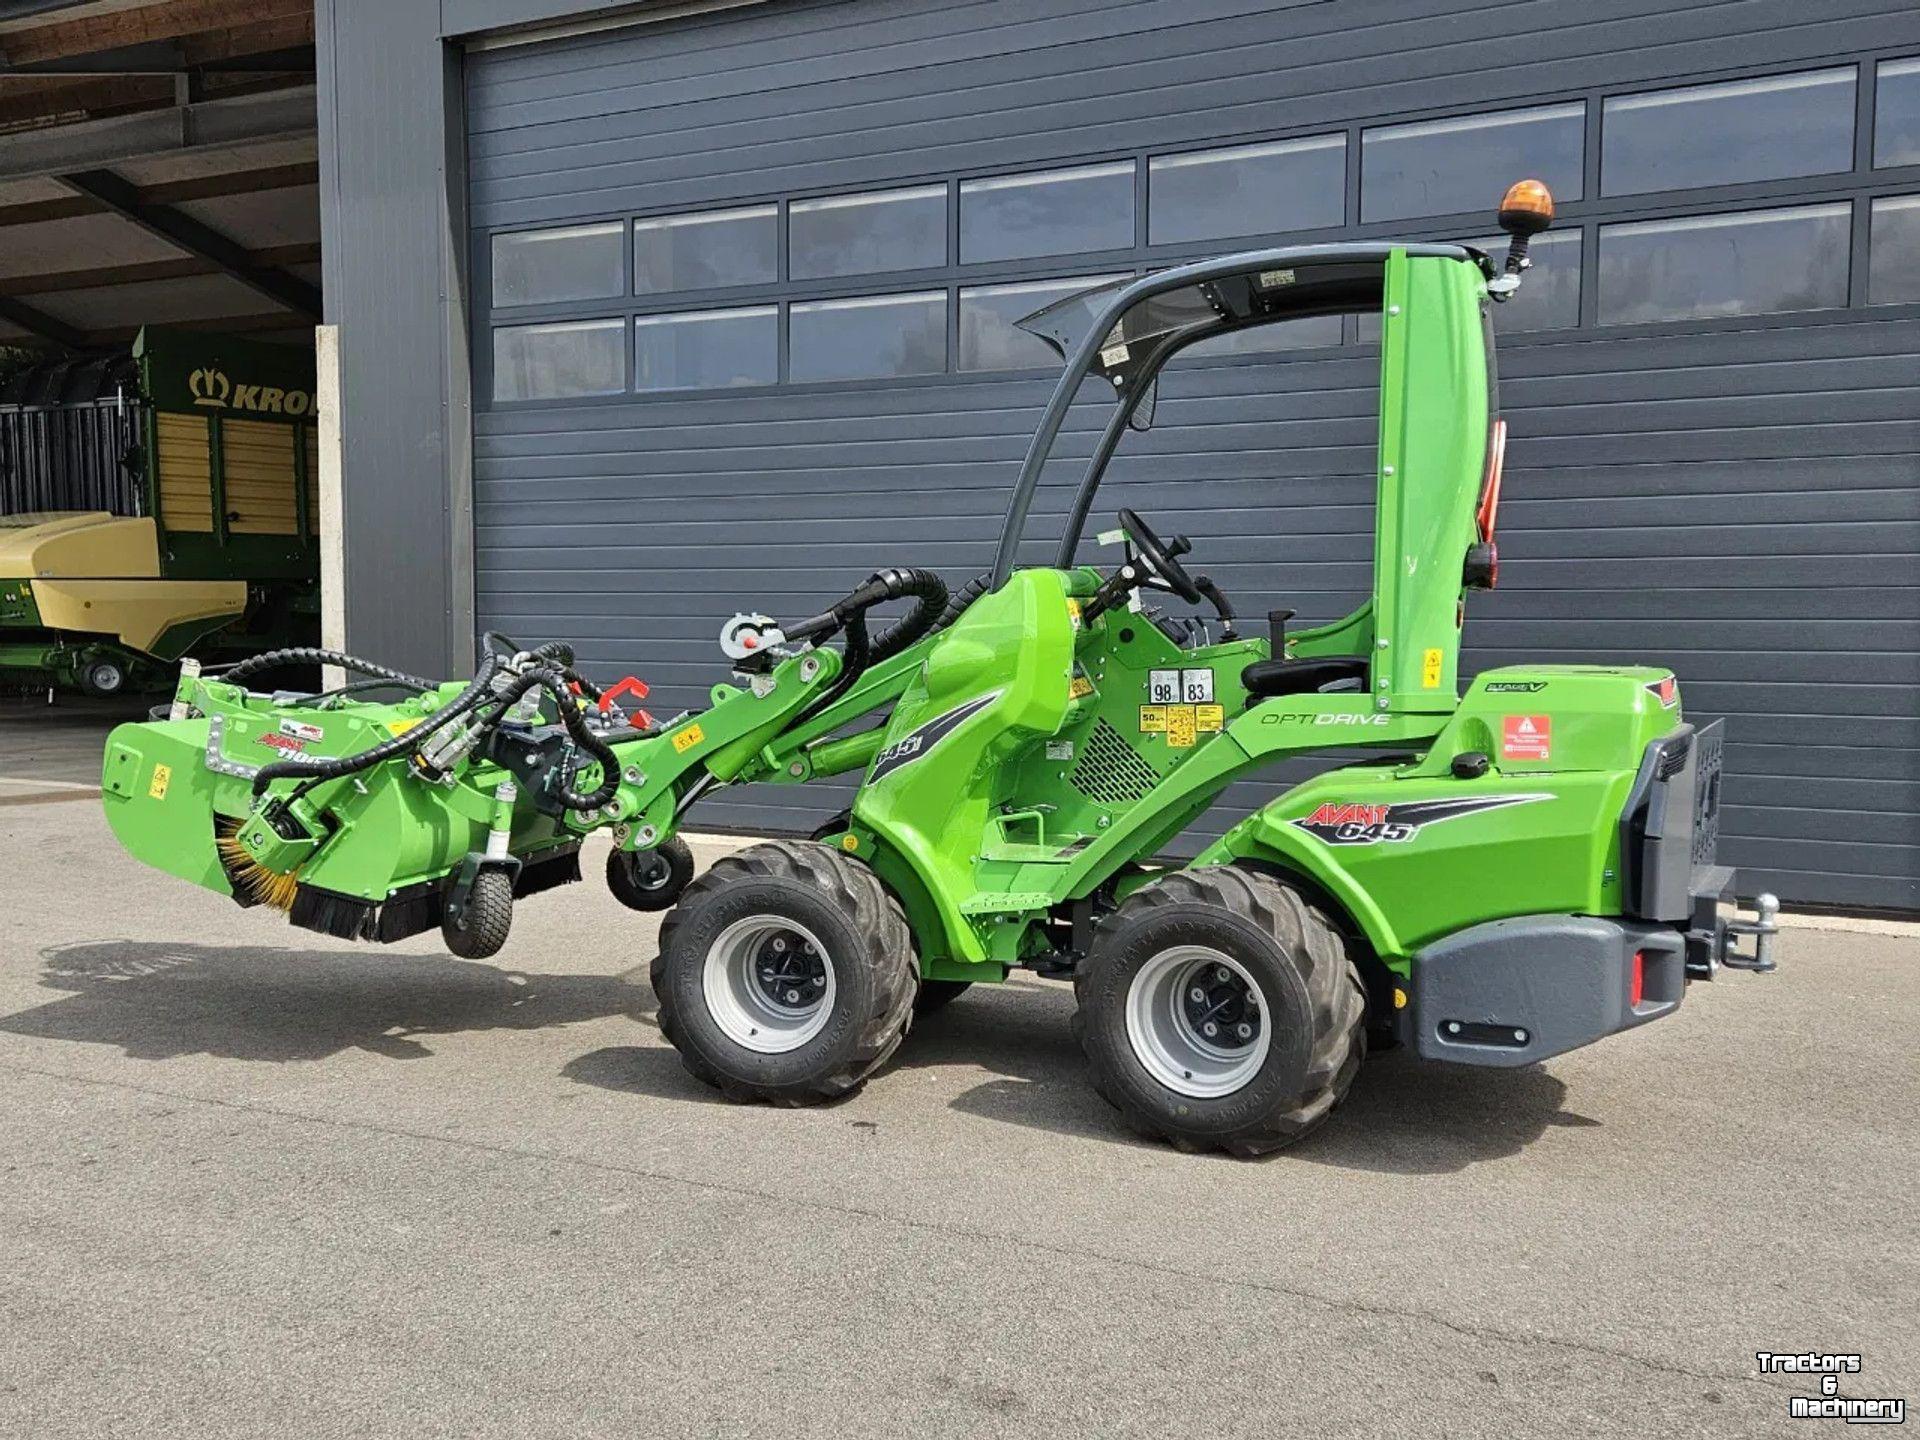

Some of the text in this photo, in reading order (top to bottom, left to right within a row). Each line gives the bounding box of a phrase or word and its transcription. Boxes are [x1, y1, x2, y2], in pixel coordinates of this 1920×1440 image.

[1154, 684, 1171, 701] 98
[1188, 684, 1204, 701] 83
[1261, 713, 1392, 725] OPTIDRIVE
[1303, 803, 1390, 827] AVANT
